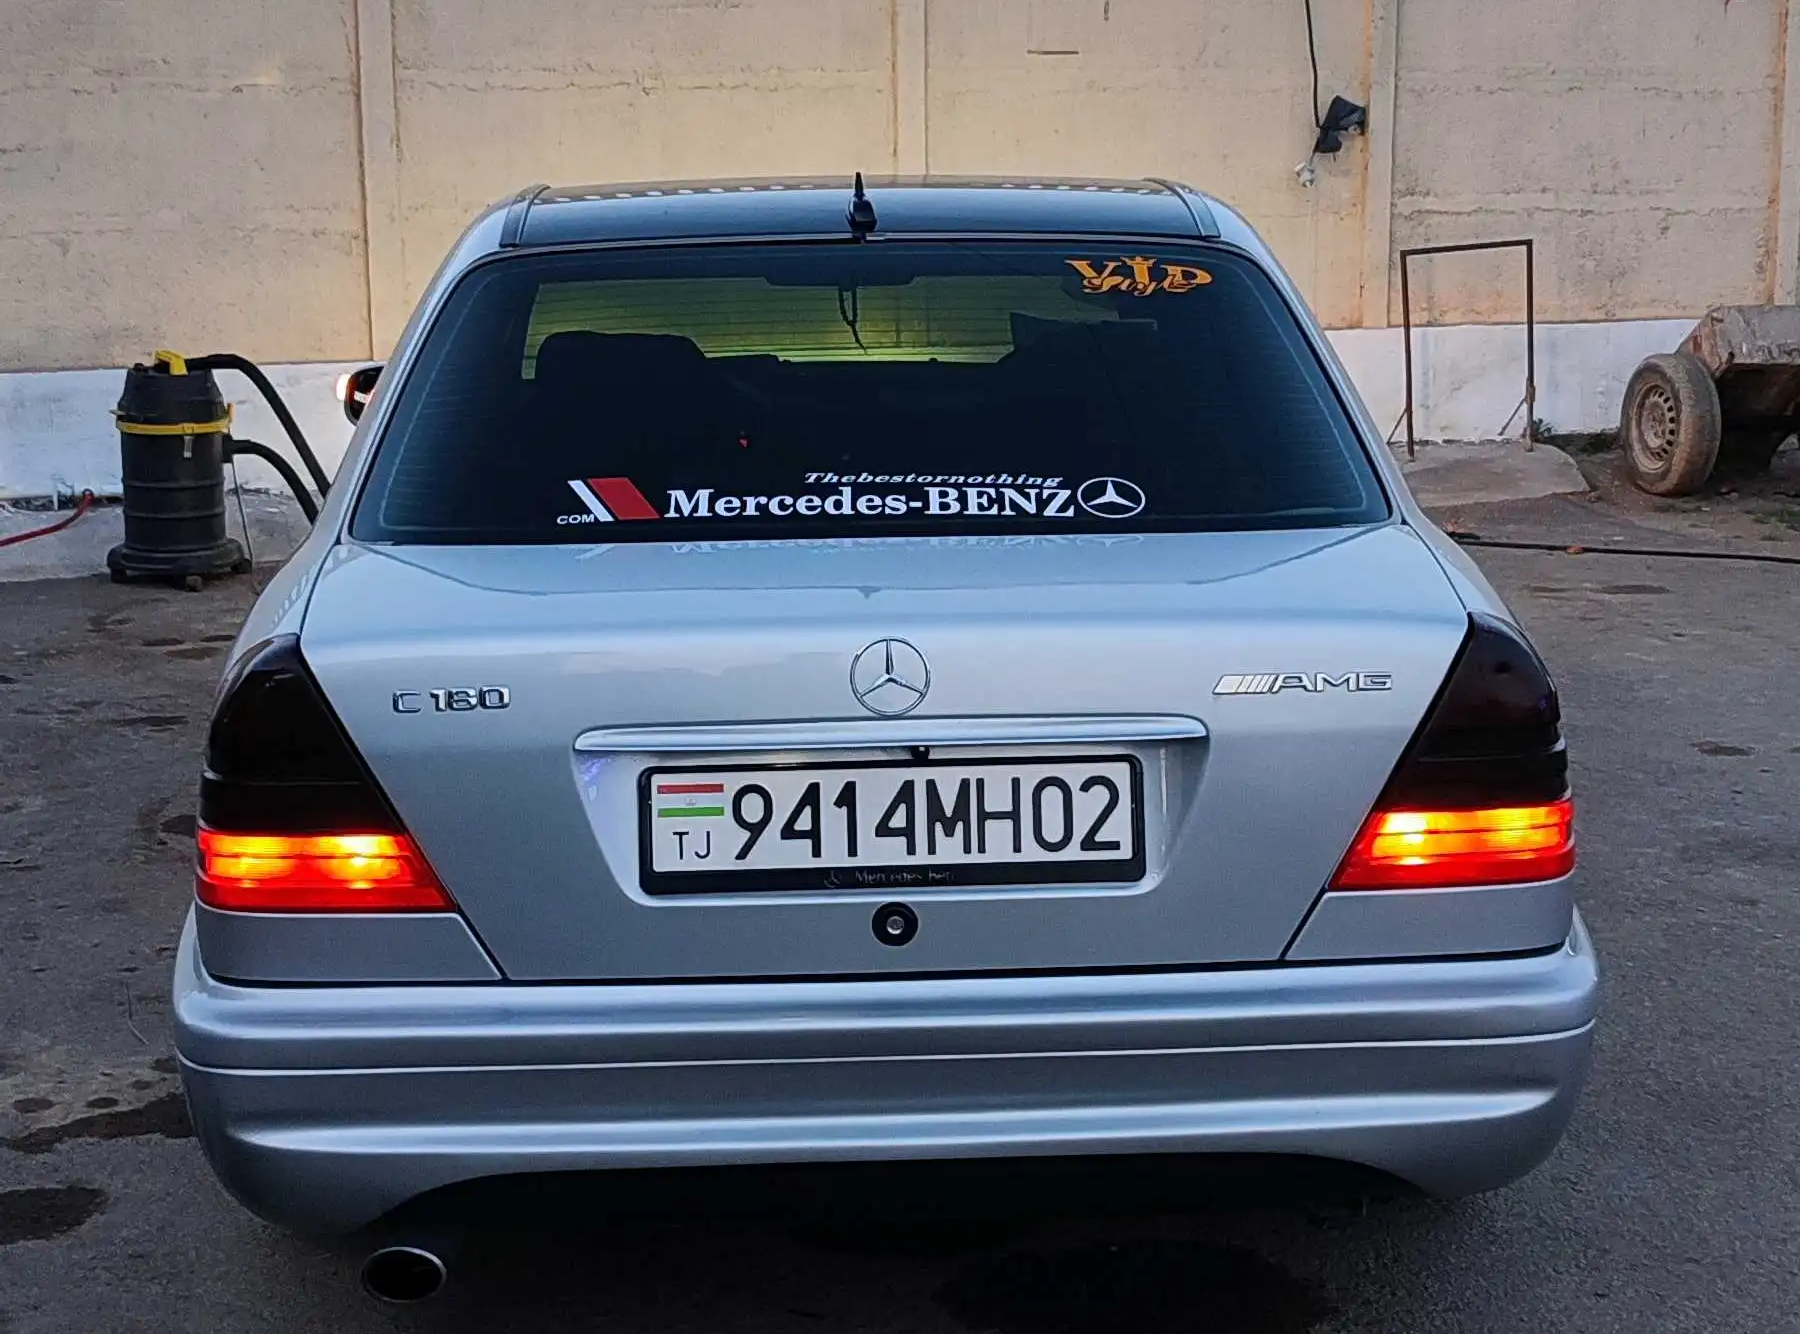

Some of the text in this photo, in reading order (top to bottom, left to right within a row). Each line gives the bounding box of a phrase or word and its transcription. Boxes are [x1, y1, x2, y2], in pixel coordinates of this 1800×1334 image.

[1064, 256, 1212, 287] VIP
[804, 472, 1064, 488] Thebestornothing
[664, 486, 1075, 517] Mercedes-BENZ
[1270, 672, 1392, 694] AMG
[392, 689, 422, 714] C
[731, 775, 1121, 860] 9414MH02
[672, 830, 711, 860] TJ
